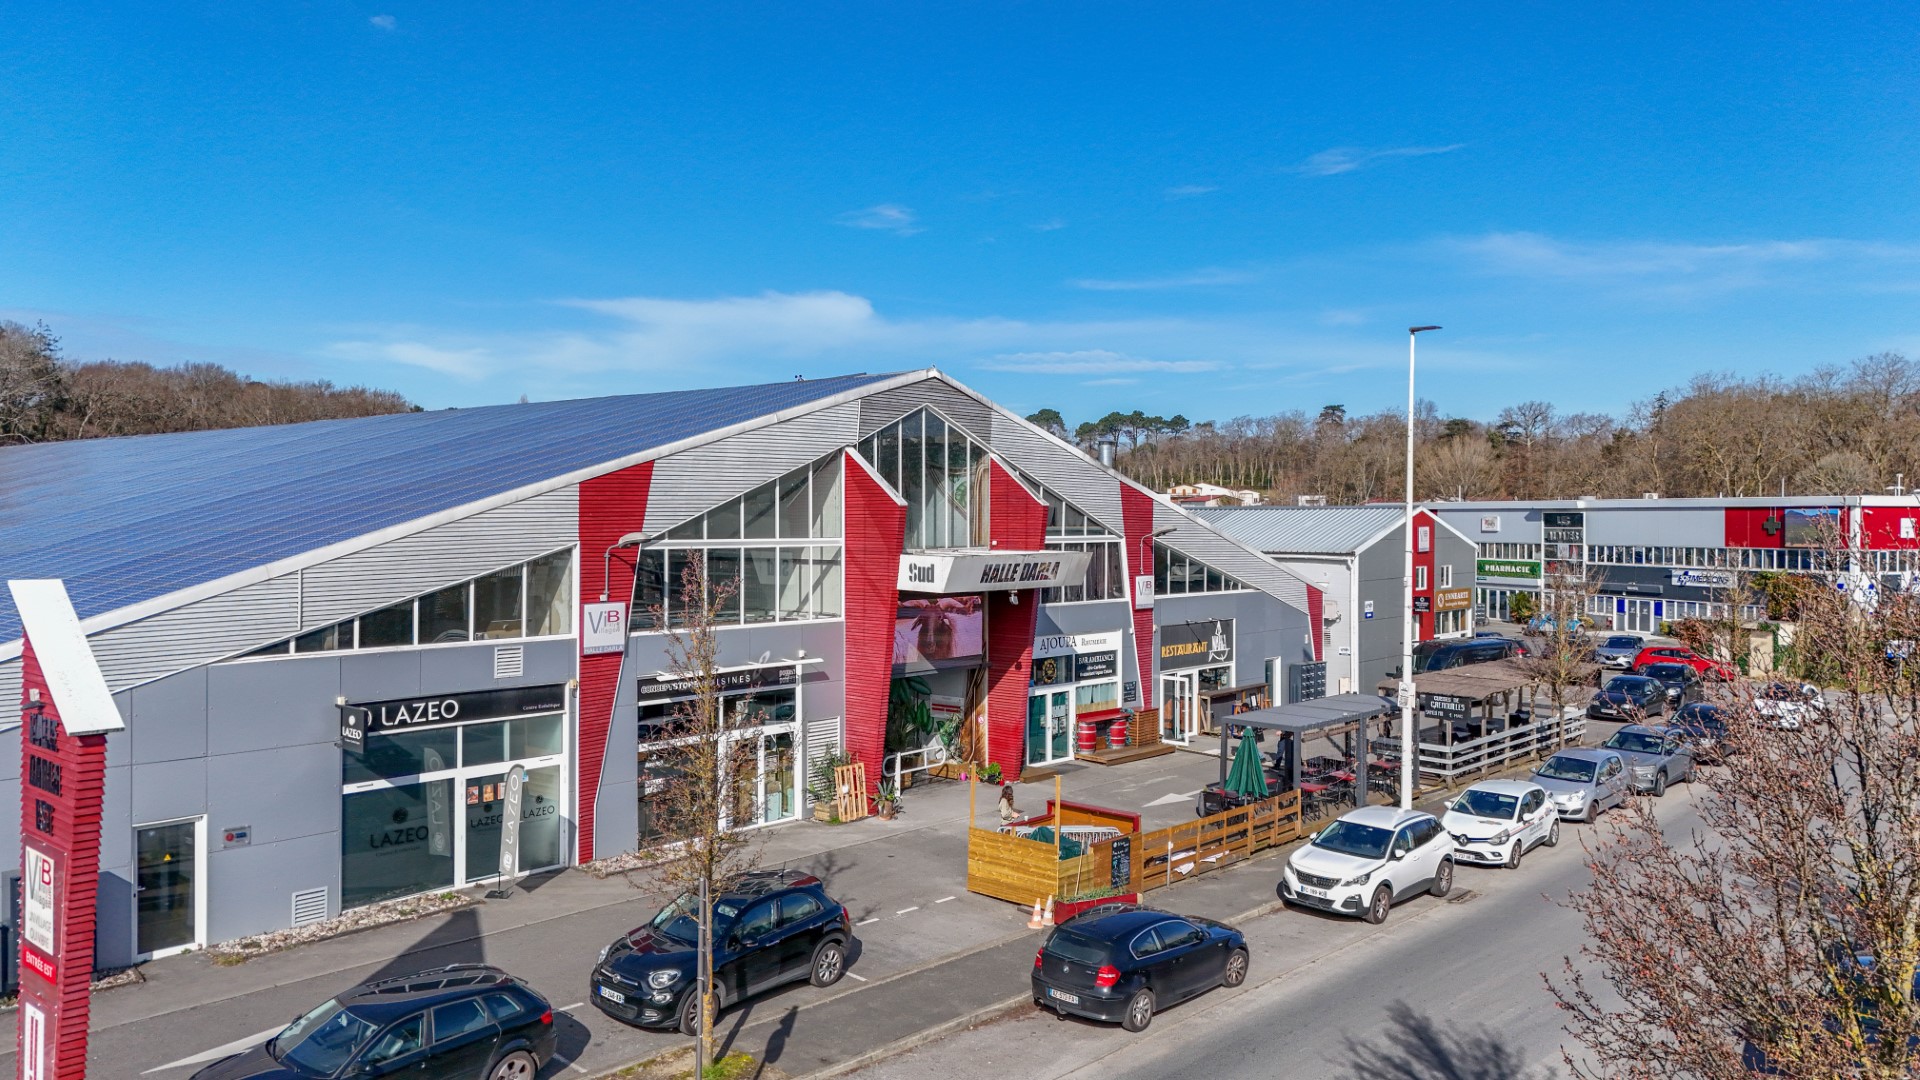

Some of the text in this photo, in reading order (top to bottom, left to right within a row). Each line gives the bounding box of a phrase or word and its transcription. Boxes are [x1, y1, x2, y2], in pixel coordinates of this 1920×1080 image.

[909, 563, 935, 583] Sud
[980, 561, 1060, 583] HALLE DARLA
[1485, 564, 1530, 573] PHARMACIE
[1040, 636, 1077, 654] AJOUPA
[1161, 641, 1208, 658] RESTAURANT
[381, 700, 459, 726] LAZEO
[342, 726, 362, 741] LAZEO
[507, 774, 520, 845] LAZEO
[523, 804, 556, 819] LAZEO
[369, 825, 429, 850] LAZEO
[26, 951, 53, 978] ENTRÉE EST
